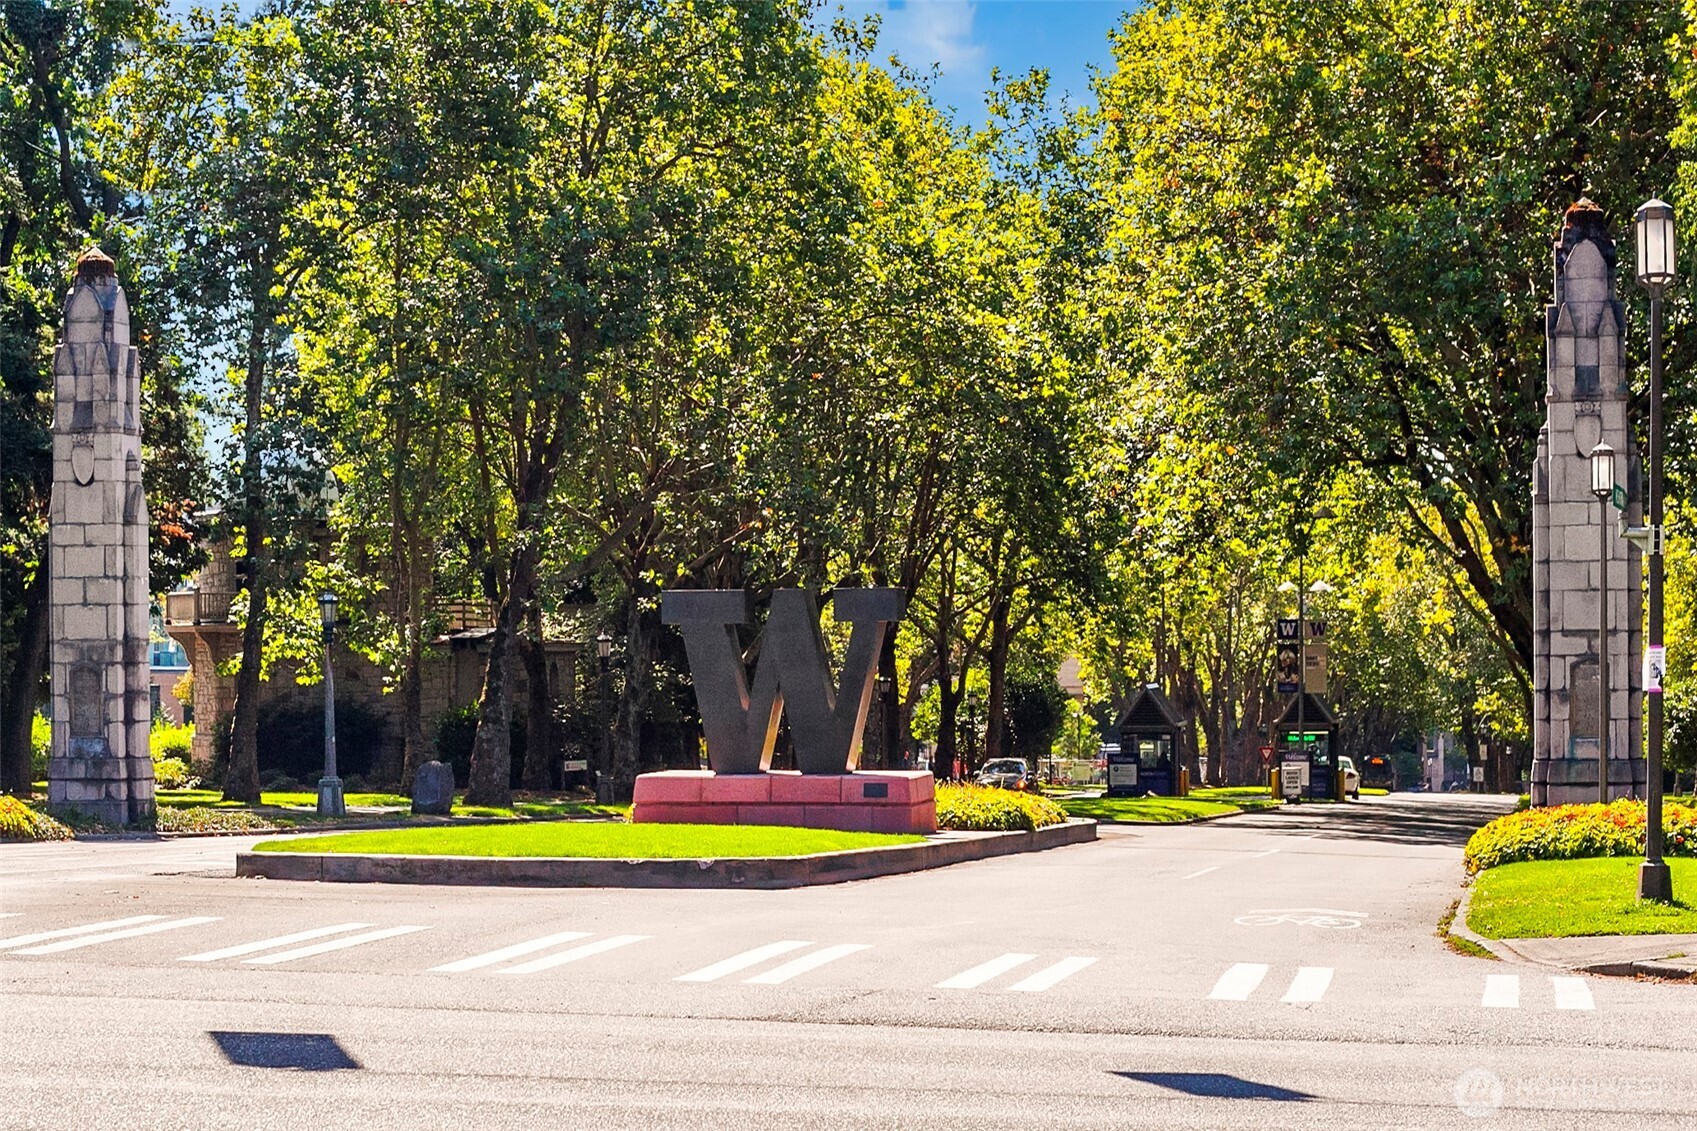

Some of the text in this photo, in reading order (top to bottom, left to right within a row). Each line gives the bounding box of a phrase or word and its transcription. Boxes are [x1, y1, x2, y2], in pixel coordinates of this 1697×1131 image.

[1280, 622, 1296, 636] W
[1310, 622, 1327, 636] W
[661, 588, 906, 775] W
